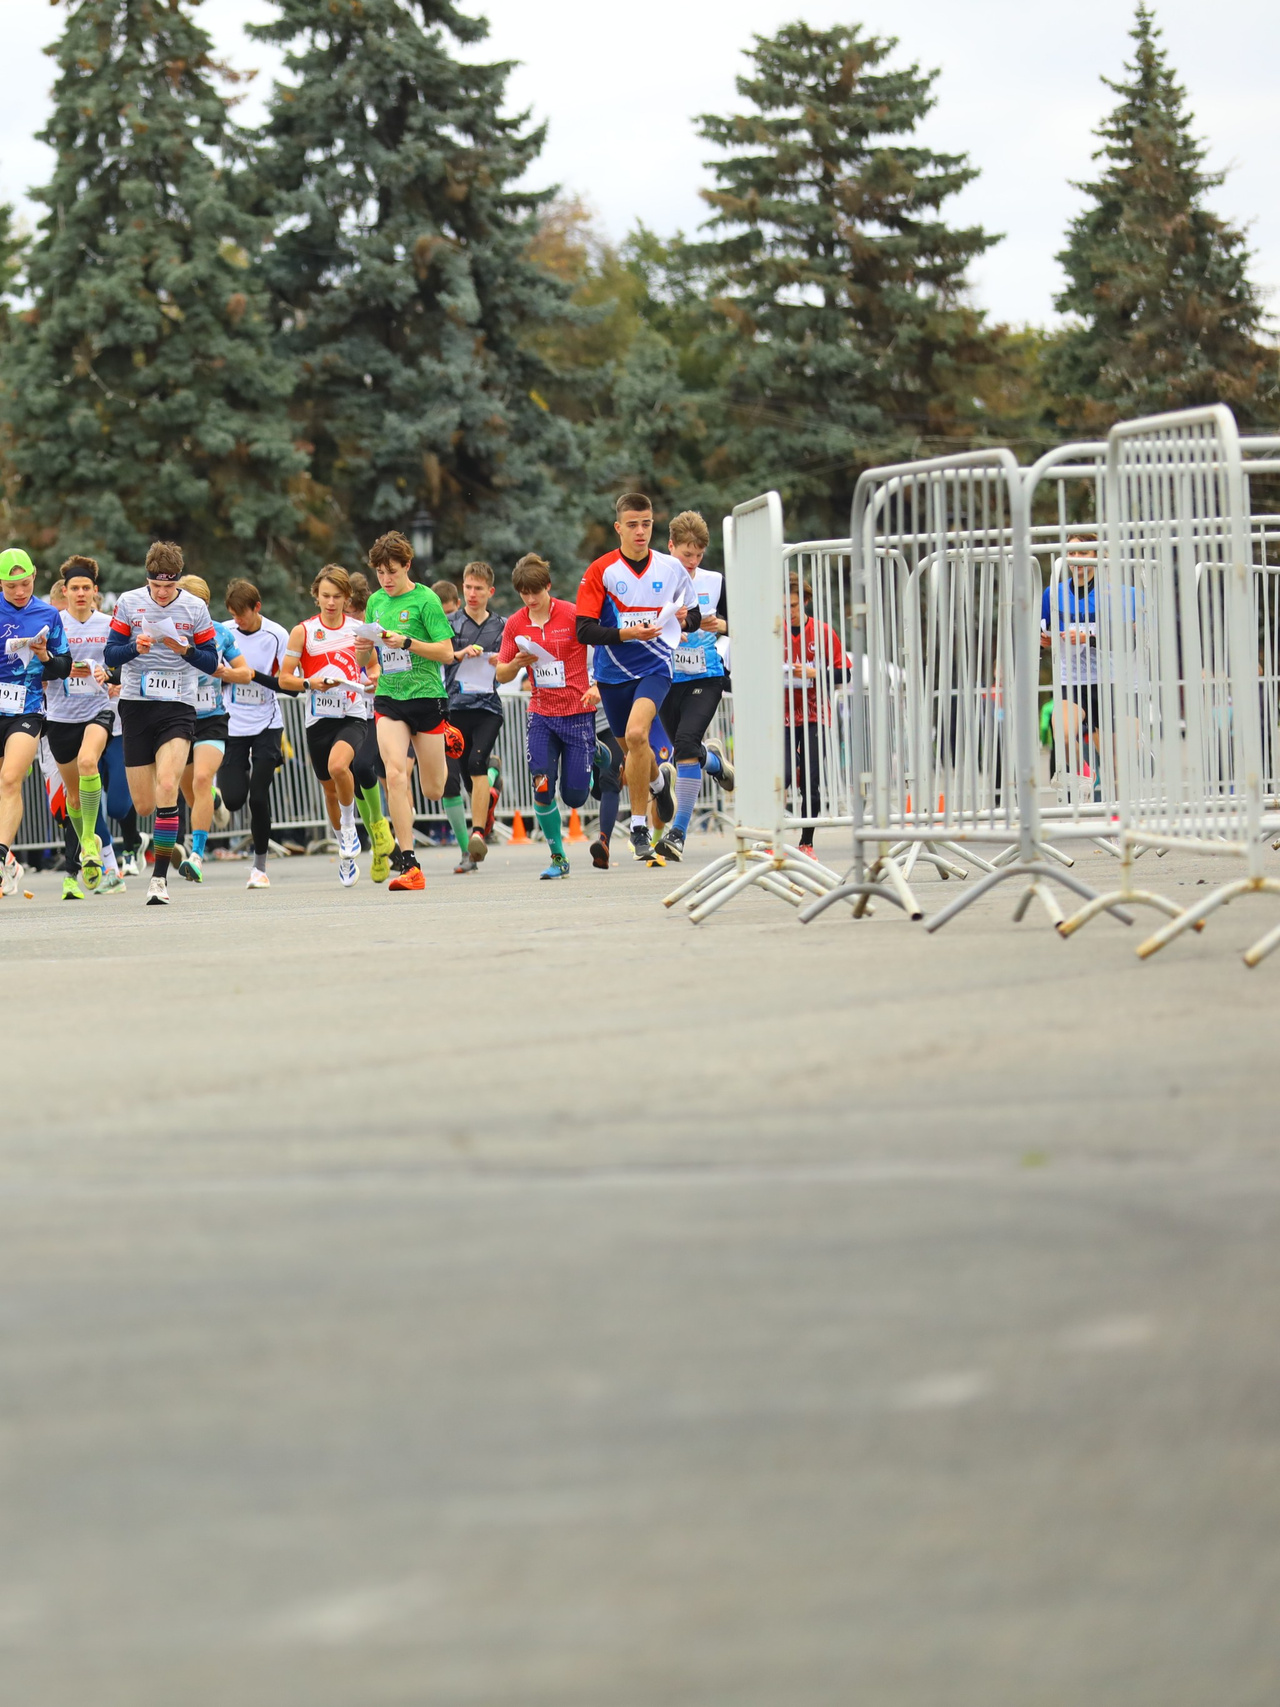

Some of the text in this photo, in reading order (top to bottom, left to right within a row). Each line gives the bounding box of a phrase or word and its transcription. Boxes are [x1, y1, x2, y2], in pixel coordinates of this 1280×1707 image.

[175, 622, 194, 630] EST
[85, 636, 109, 644] WES
[334, 653, 349, 665] Run
[675, 653, 699, 664] 204.1
[536, 667, 558, 677] 206.1
[148, 678, 176, 689] 210.1
[236, 687, 259, 698] 217.1
[316, 697, 341, 708] 209.1
